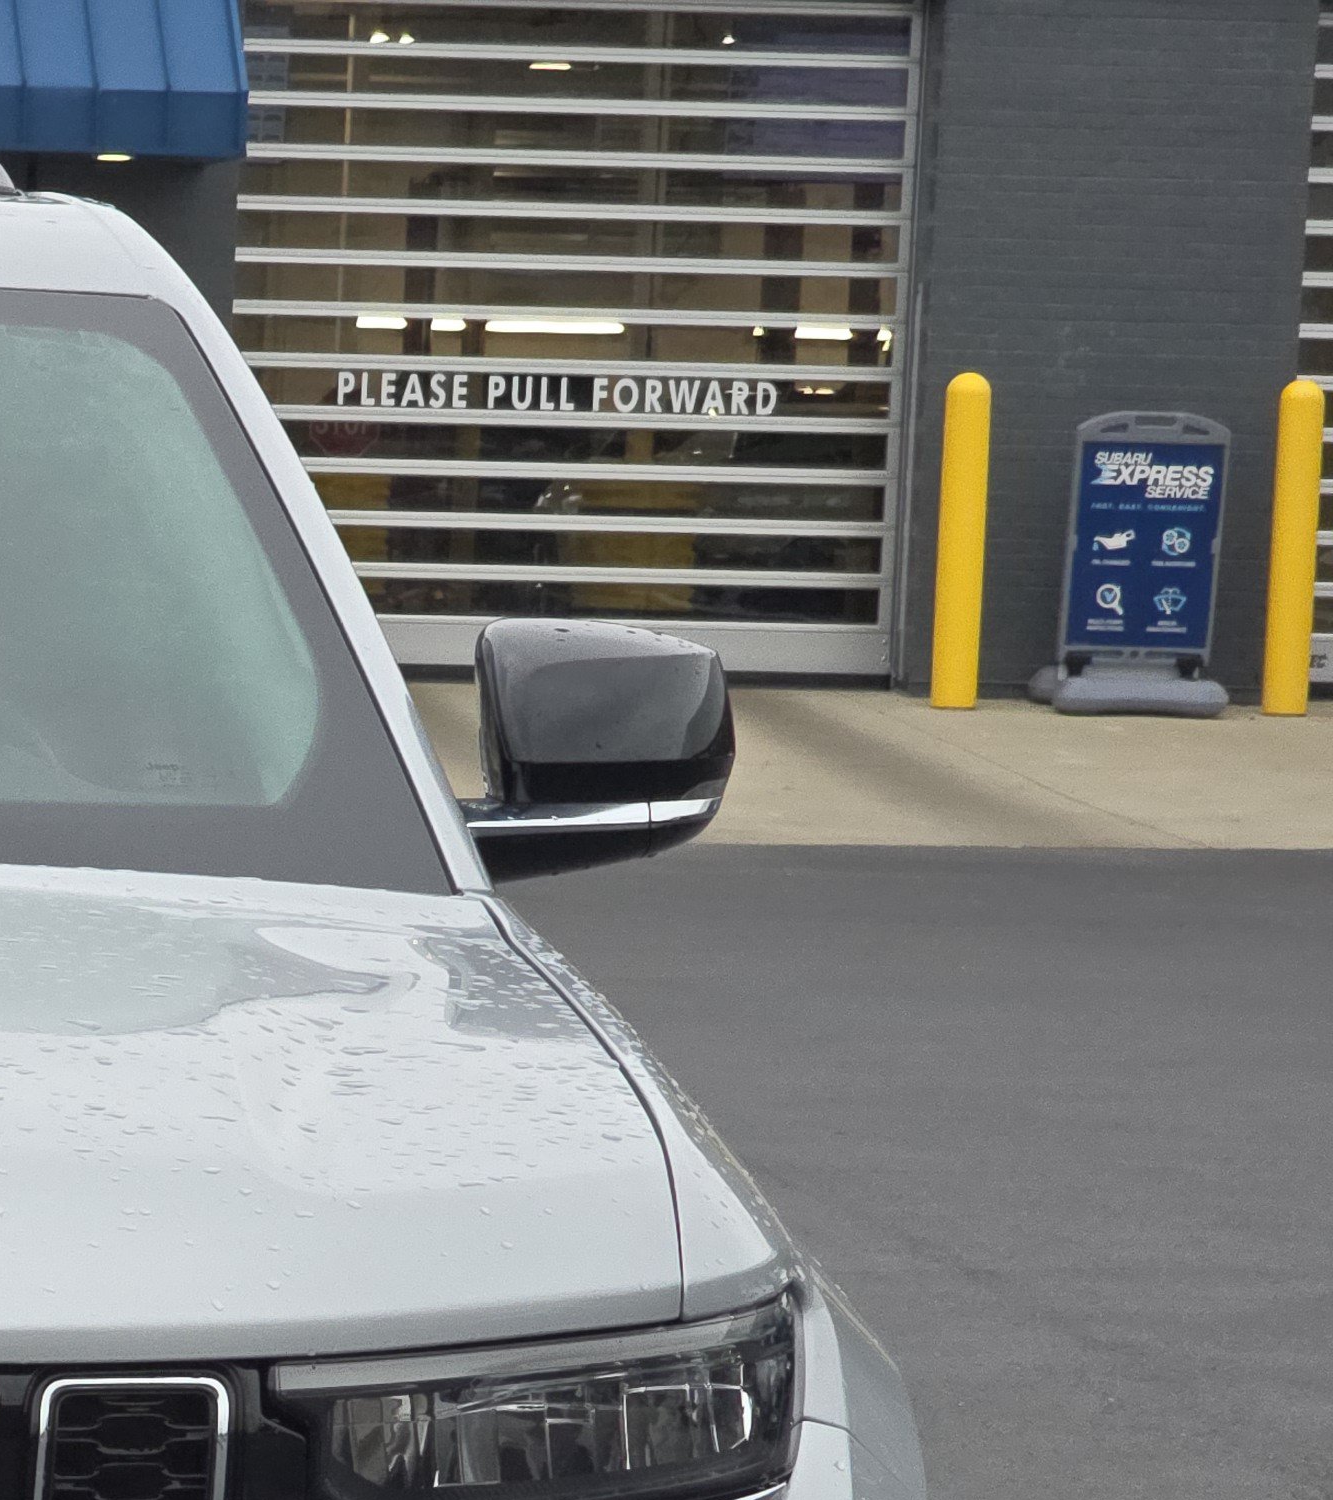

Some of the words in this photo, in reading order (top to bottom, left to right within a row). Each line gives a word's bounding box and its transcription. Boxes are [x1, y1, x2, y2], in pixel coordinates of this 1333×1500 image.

[337, 371, 468, 409] PLEASE
[487, 375, 575, 411] PULL
[592, 377, 778, 416] FORWARD
[1094, 451, 1152, 464] SUBARU
[1090, 465, 1214, 486] EXPRESS
[1144, 486, 1210, 499] SERVICE
